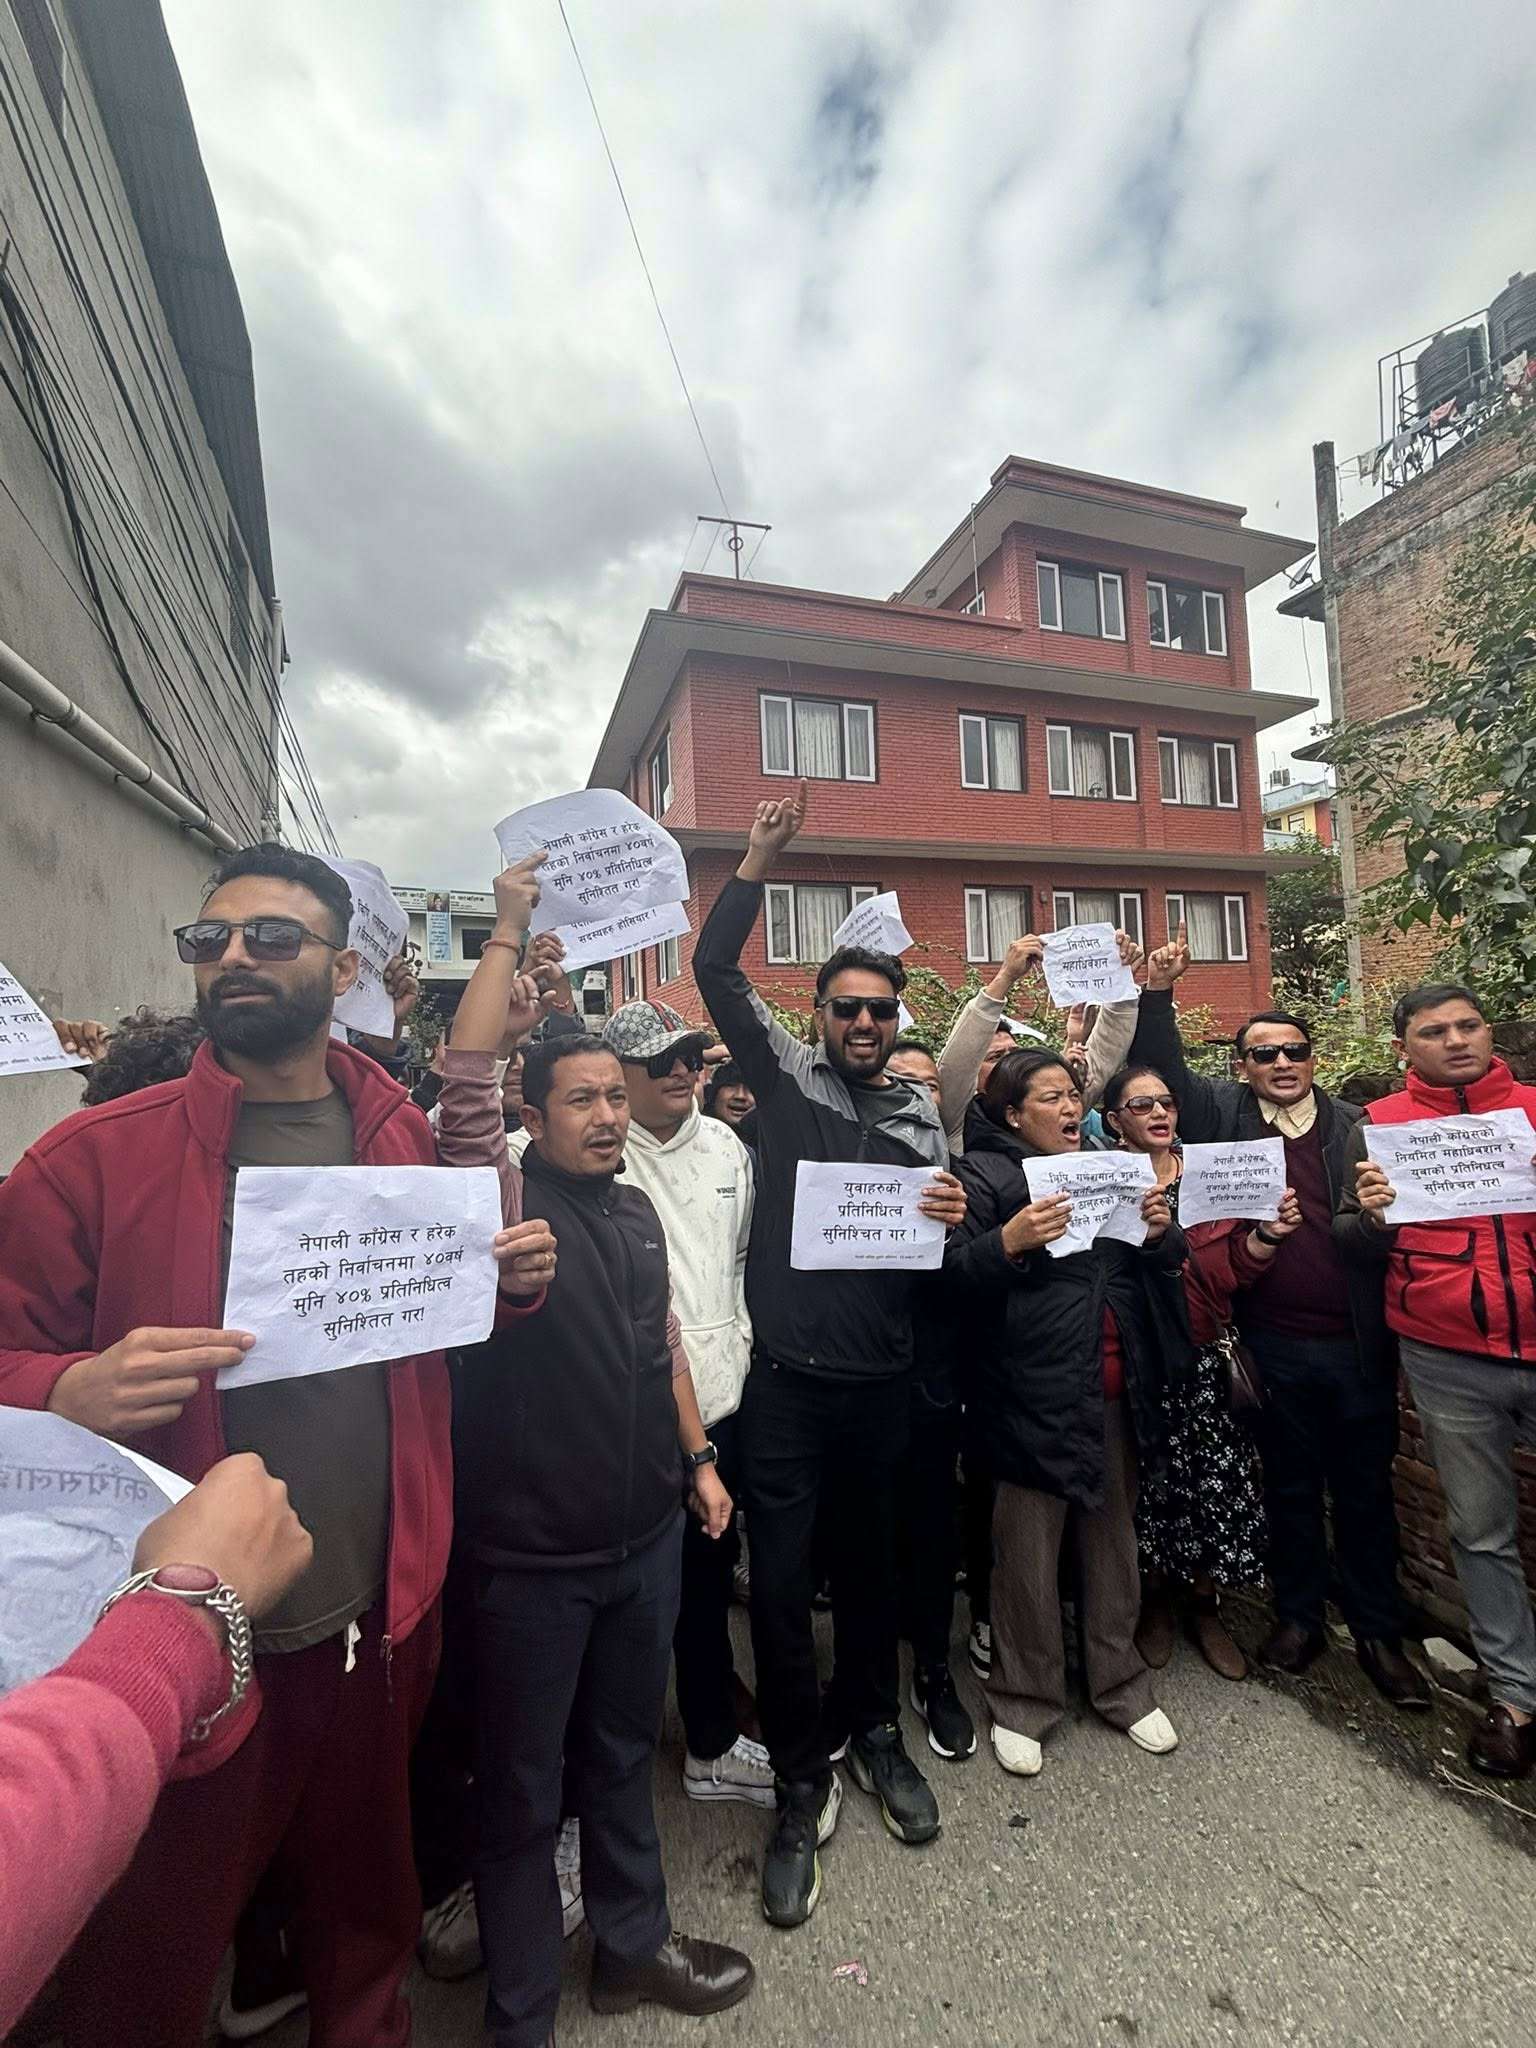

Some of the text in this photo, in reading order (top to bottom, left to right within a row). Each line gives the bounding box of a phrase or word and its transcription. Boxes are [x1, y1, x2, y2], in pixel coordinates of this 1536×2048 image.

[542, 834, 575, 851] नेपाली
[610, 827, 617, 836] र
[574, 845, 621, 864] निर्वाचनमा
[553, 874, 573, 891] मुनि
[604, 856, 653, 875] प्रतिनिधित्व
[1066, 936, 1101, 951] नियमित
[1062, 956, 1108, 972] महाधिवेशन
[1409, 1132, 1442, 1146] नेपाली
[1395, 1150, 1436, 1163] नियमित
[1509, 1143, 1515, 1151] र
[1410, 1164, 1445, 1180] युवाको
[843, 1180, 903, 1198] युवाहरुको
[838, 1201, 904, 1217] प्रतिनिधित्व
[299, 1222, 457, 1252] नेपाली काँग्रेस र हरेक
[822, 1225, 883, 1245] सुनिश्चित
[283, 1245, 464, 1286] तहको निर्वाचनमा ४०वर्ष
[293, 1275, 453, 1318] मुनि ४०% प्रतिनिधित्व
[402, 1306, 425, 1324] गर!
